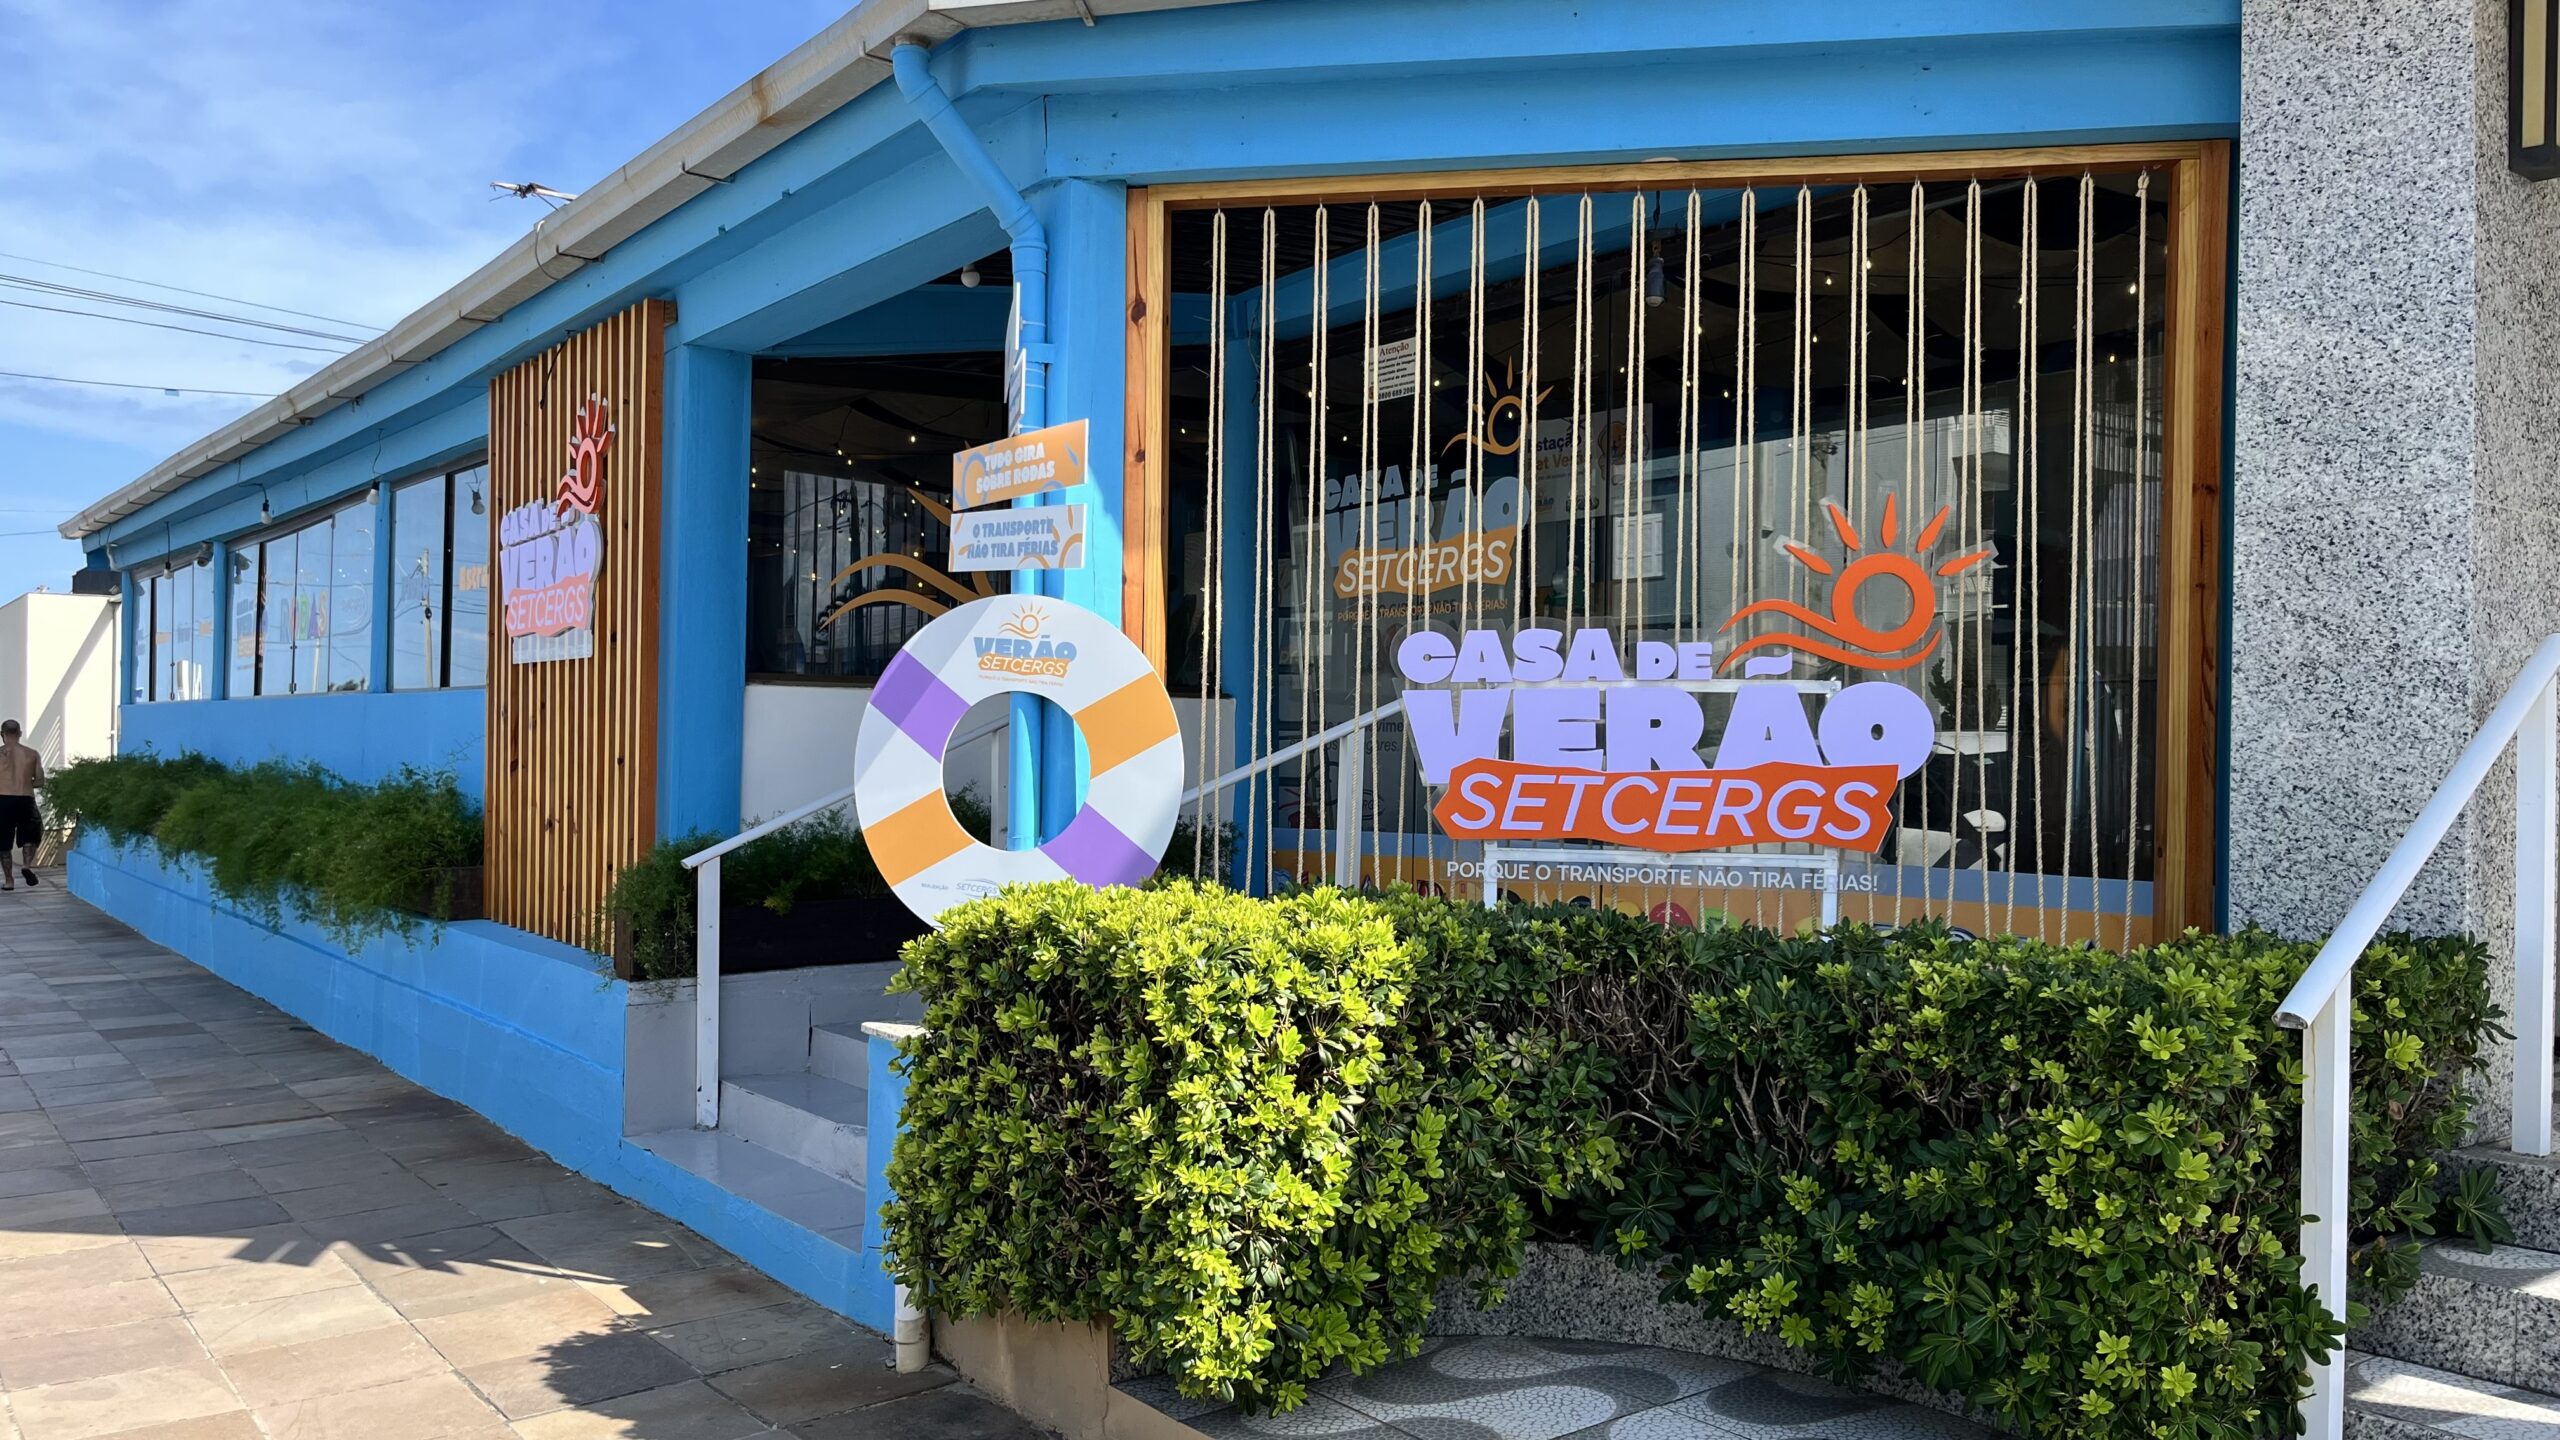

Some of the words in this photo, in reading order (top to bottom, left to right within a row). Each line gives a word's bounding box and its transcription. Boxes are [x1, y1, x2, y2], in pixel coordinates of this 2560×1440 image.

[1380, 342, 1409, 356] Atenção
[984, 450, 1012, 471] TUDO
[1015, 442, 1044, 464] GIRA
[976, 470, 1011, 494] SOBRE
[1014, 461, 1055, 484] RODAS
[500, 503, 541, 547] CASA
[973, 523, 980, 538] O
[982, 518, 1054, 539] TRANSPORTE
[1326, 469, 1530, 567] VERÃO
[500, 510, 597, 605] VERÃO
[967, 540, 988, 559] NÃO
[991, 542, 1015, 558] TIRA
[1017, 537, 1058, 557] FÉRIAS
[1339, 540, 1507, 593] SETCERGS
[509, 584, 585, 632] SETCERGS
[974, 635, 1077, 662] VERÃO
[1398, 628, 1624, 684] CASA
[1636, 641, 1712, 680] DE
[981, 655, 1065, 676] SETCERGS
[1402, 652, 1935, 784] VERÃO
[1450, 772, 1879, 840] SETCERGS
[956, 882, 998, 895] SETCERGS
[1447, 861, 1530, 881] PORQUE
[1535, 864, 1551, 881] O
[1557, 864, 1692, 886] TRANSPORTE
[1698, 867, 1742, 887] NÃO
[1750, 870, 1795, 890] TIRA
[1801, 870, 1878, 892] FÉRIAS!
